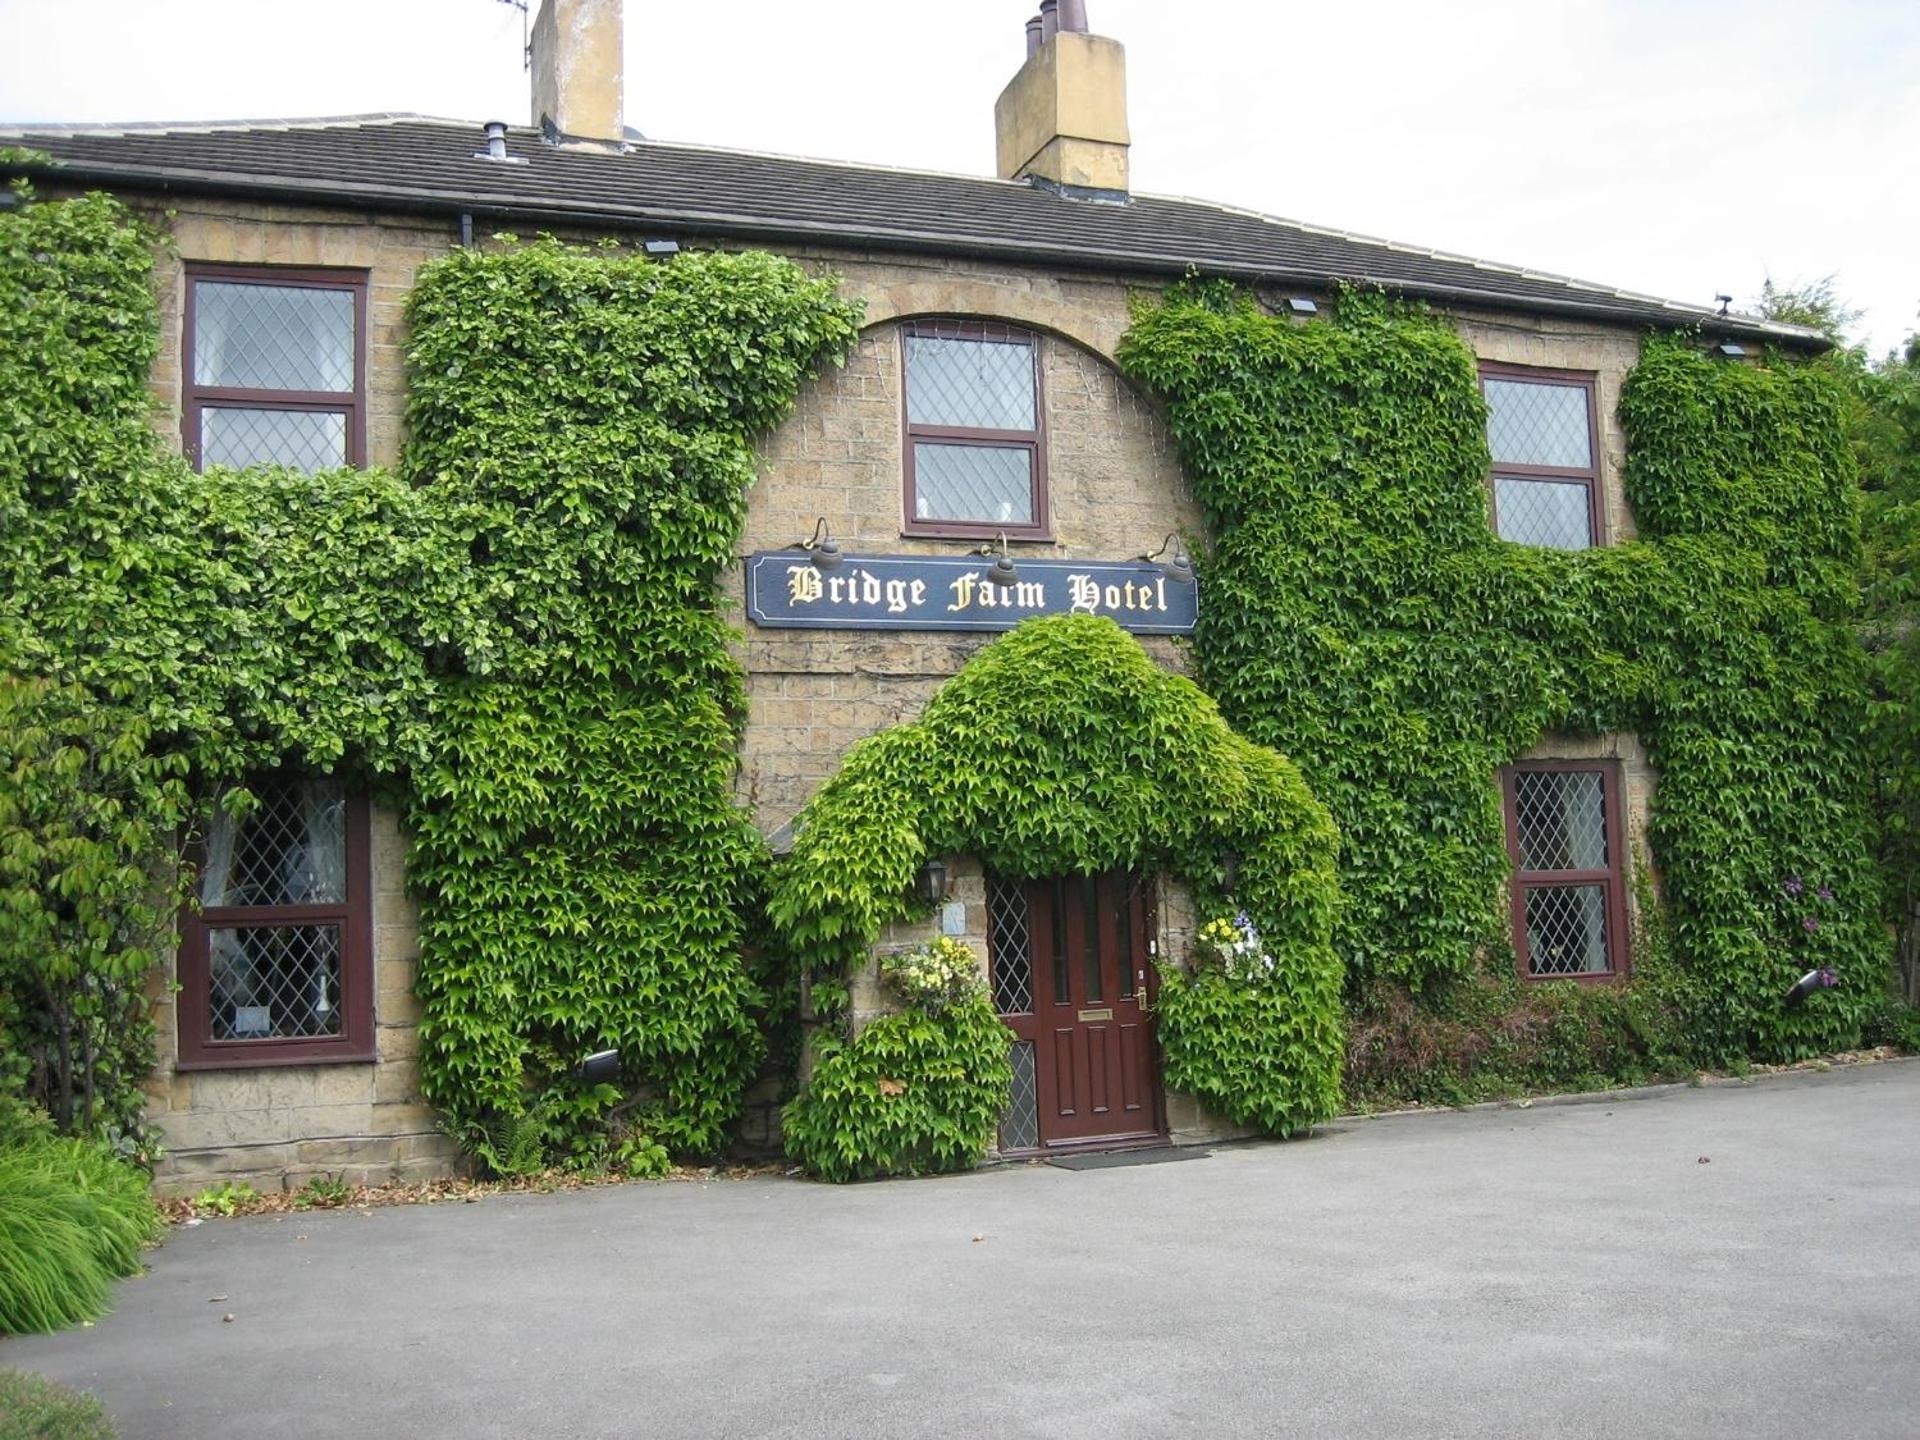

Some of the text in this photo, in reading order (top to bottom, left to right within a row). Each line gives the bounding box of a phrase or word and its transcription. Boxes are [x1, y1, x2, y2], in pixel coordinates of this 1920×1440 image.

[786, 566, 1169, 615] Bridge Farm Hotel
